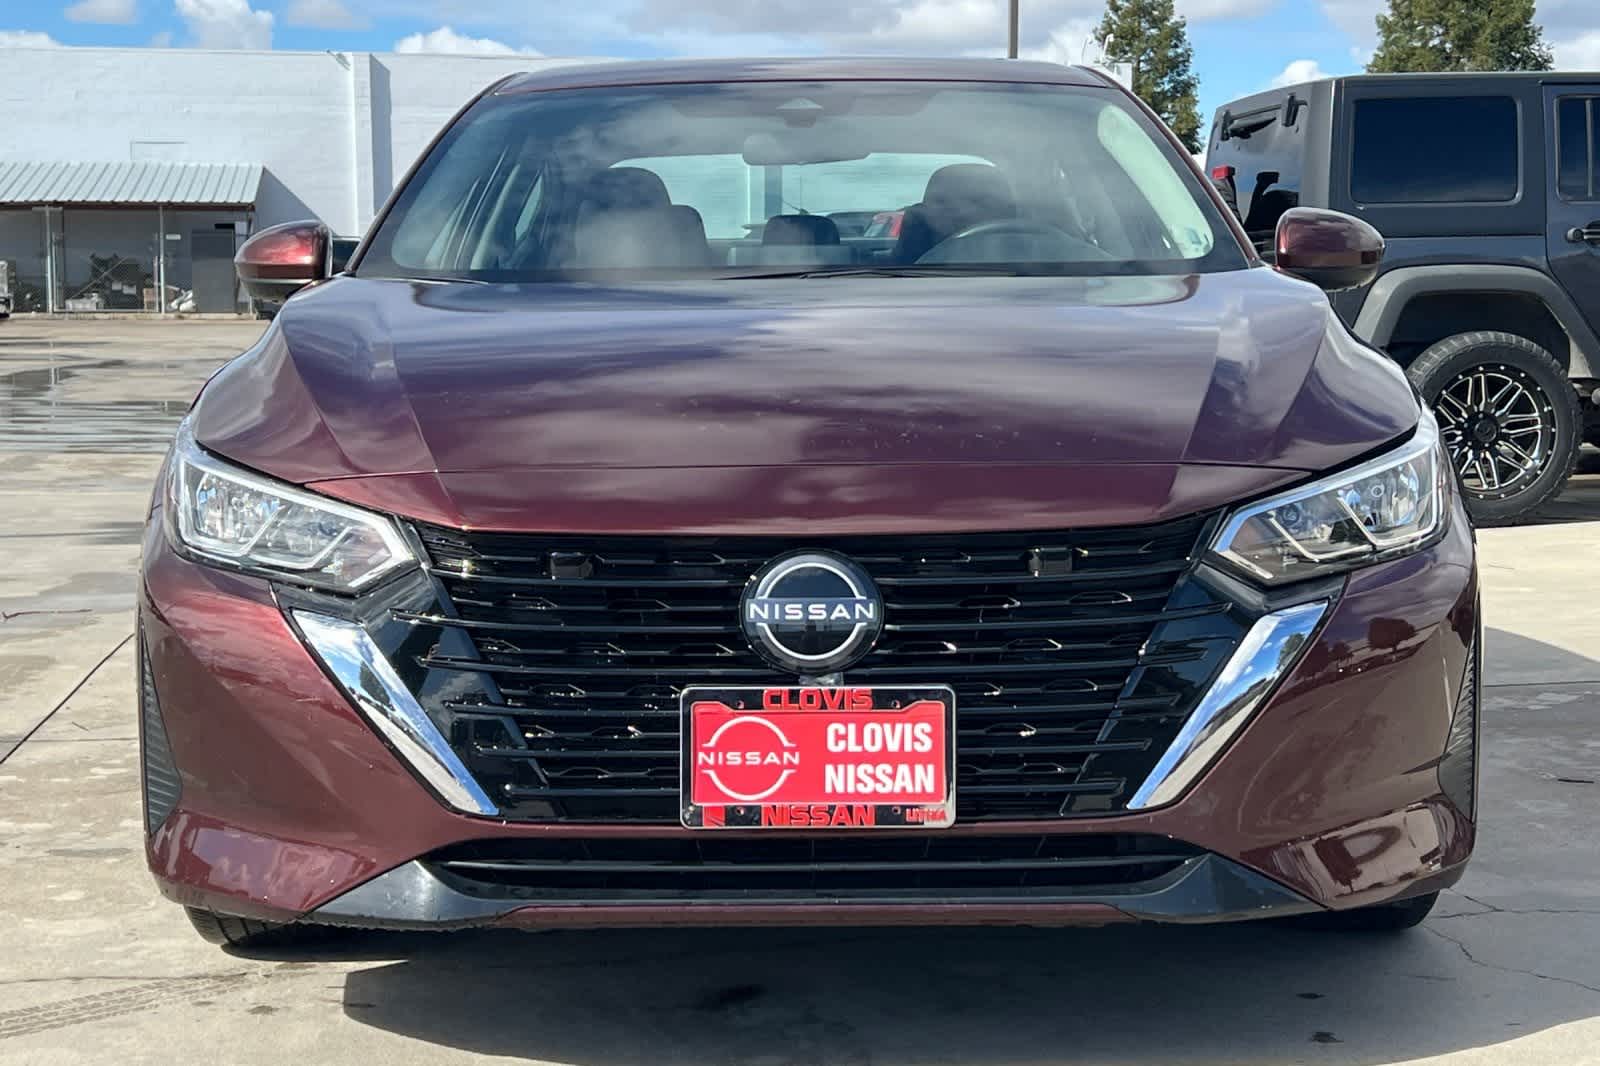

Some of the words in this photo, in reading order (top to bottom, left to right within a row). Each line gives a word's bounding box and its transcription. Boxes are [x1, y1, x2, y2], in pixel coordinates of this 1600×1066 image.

[749, 603, 873, 620] NISSAN
[763, 689, 872, 711] CLOVIS
[826, 722, 932, 752] CLOVIS
[698, 751, 800, 765] NISSAN
[825, 764, 935, 794] NISSAN
[761, 805, 875, 826] NISSAN
